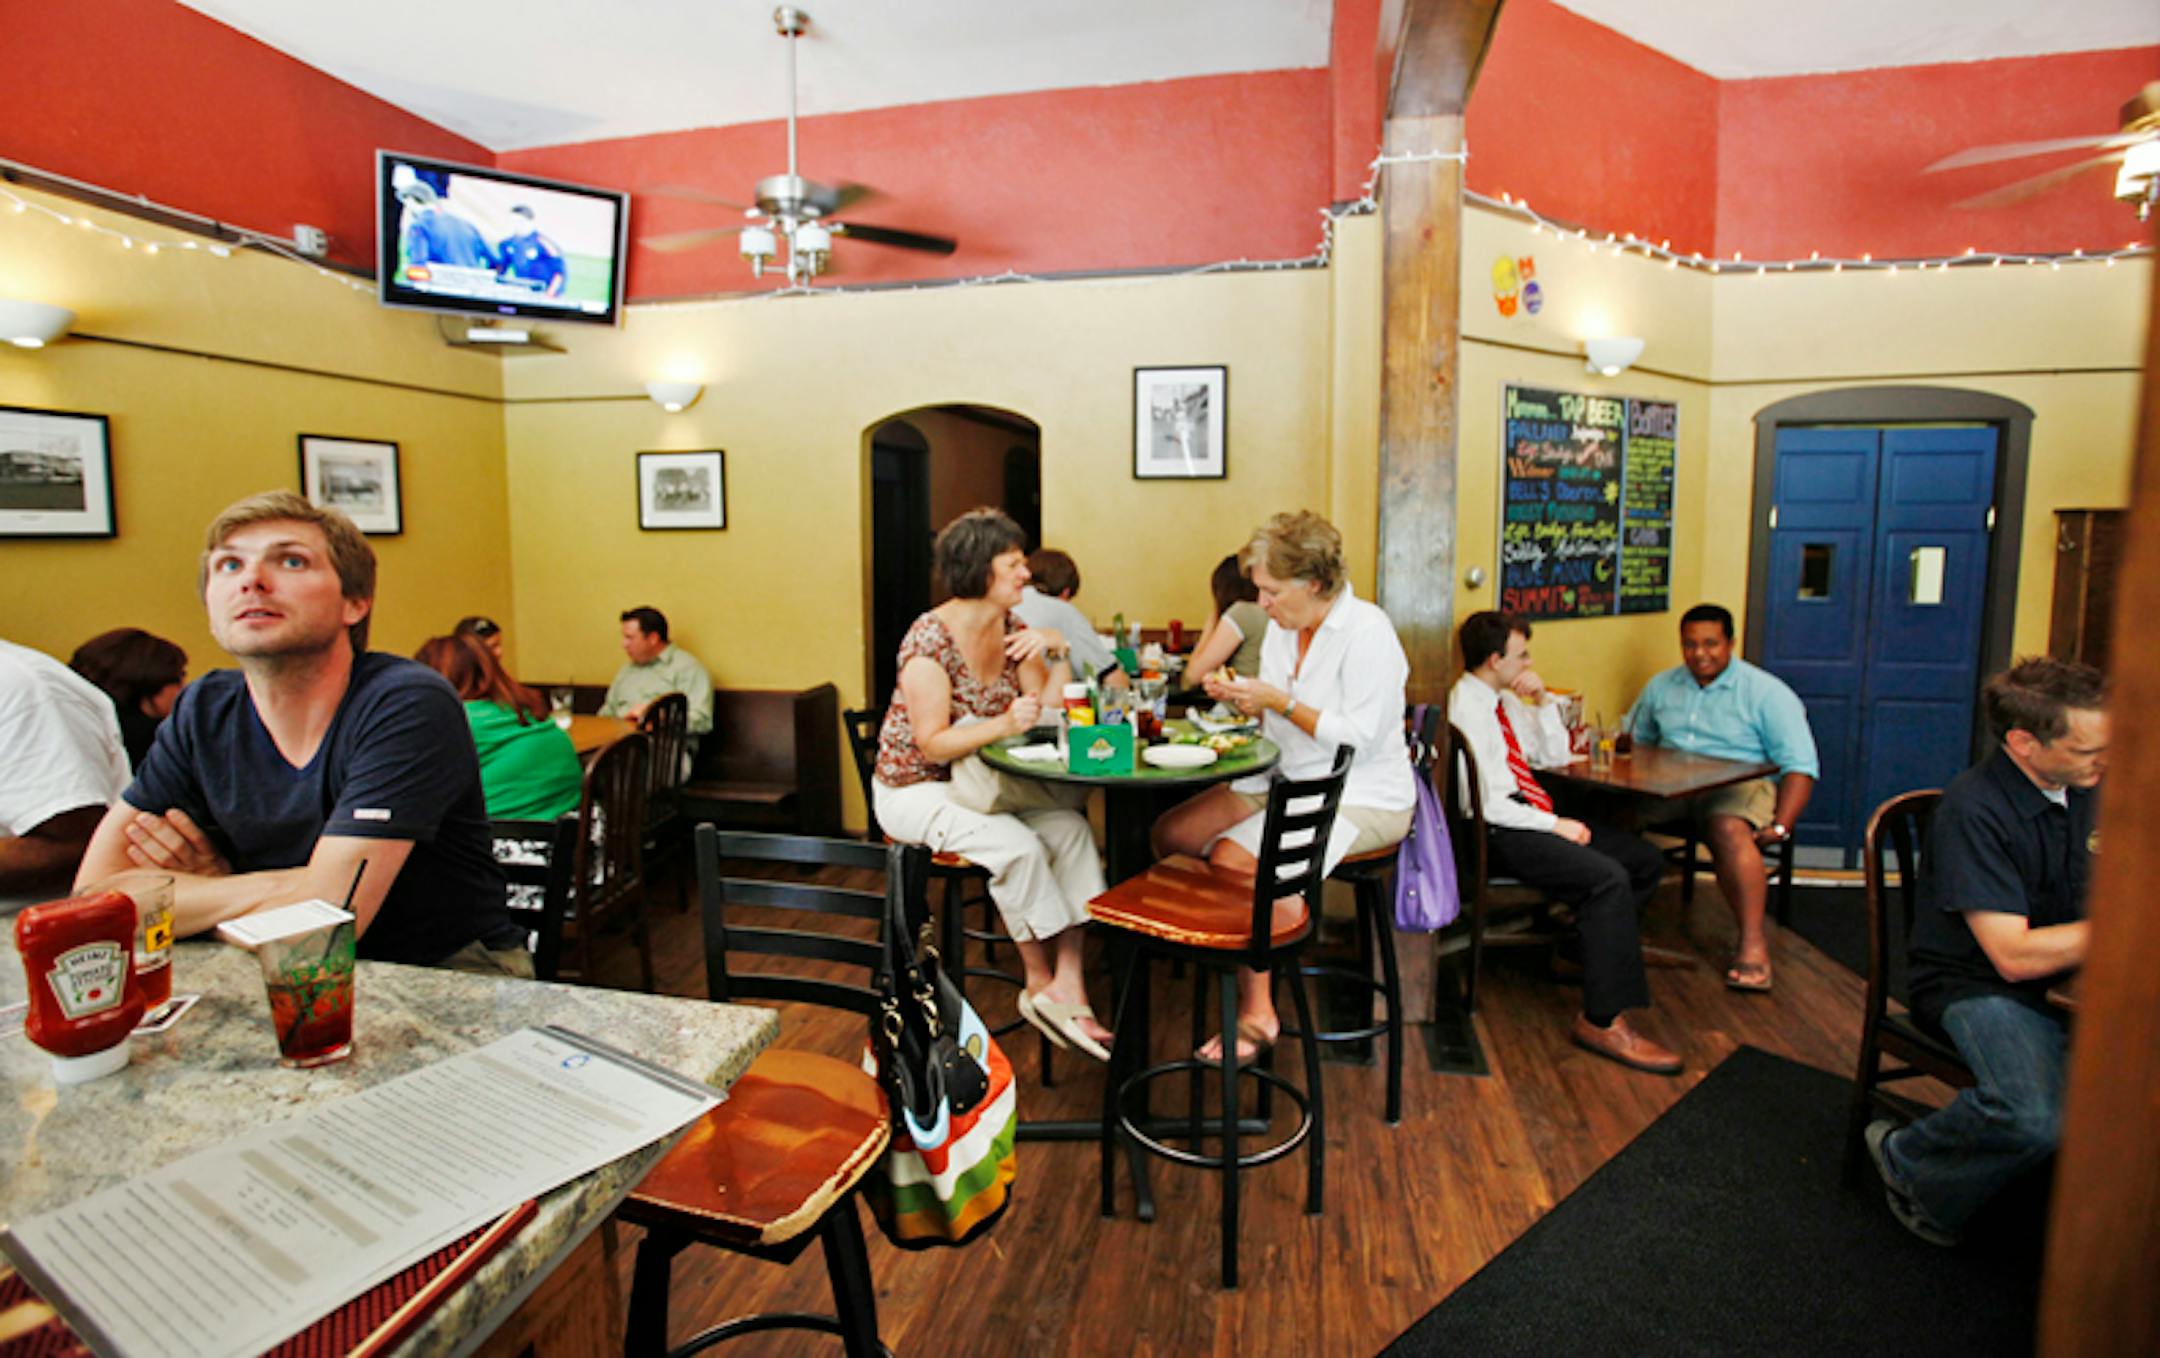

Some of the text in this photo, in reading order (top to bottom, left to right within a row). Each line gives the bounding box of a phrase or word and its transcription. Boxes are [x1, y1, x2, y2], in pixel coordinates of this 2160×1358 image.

[1559, 394, 1585, 422] TAP
[1587, 396, 1625, 429] BEER
[70, 951, 108, 966] HEINZ
